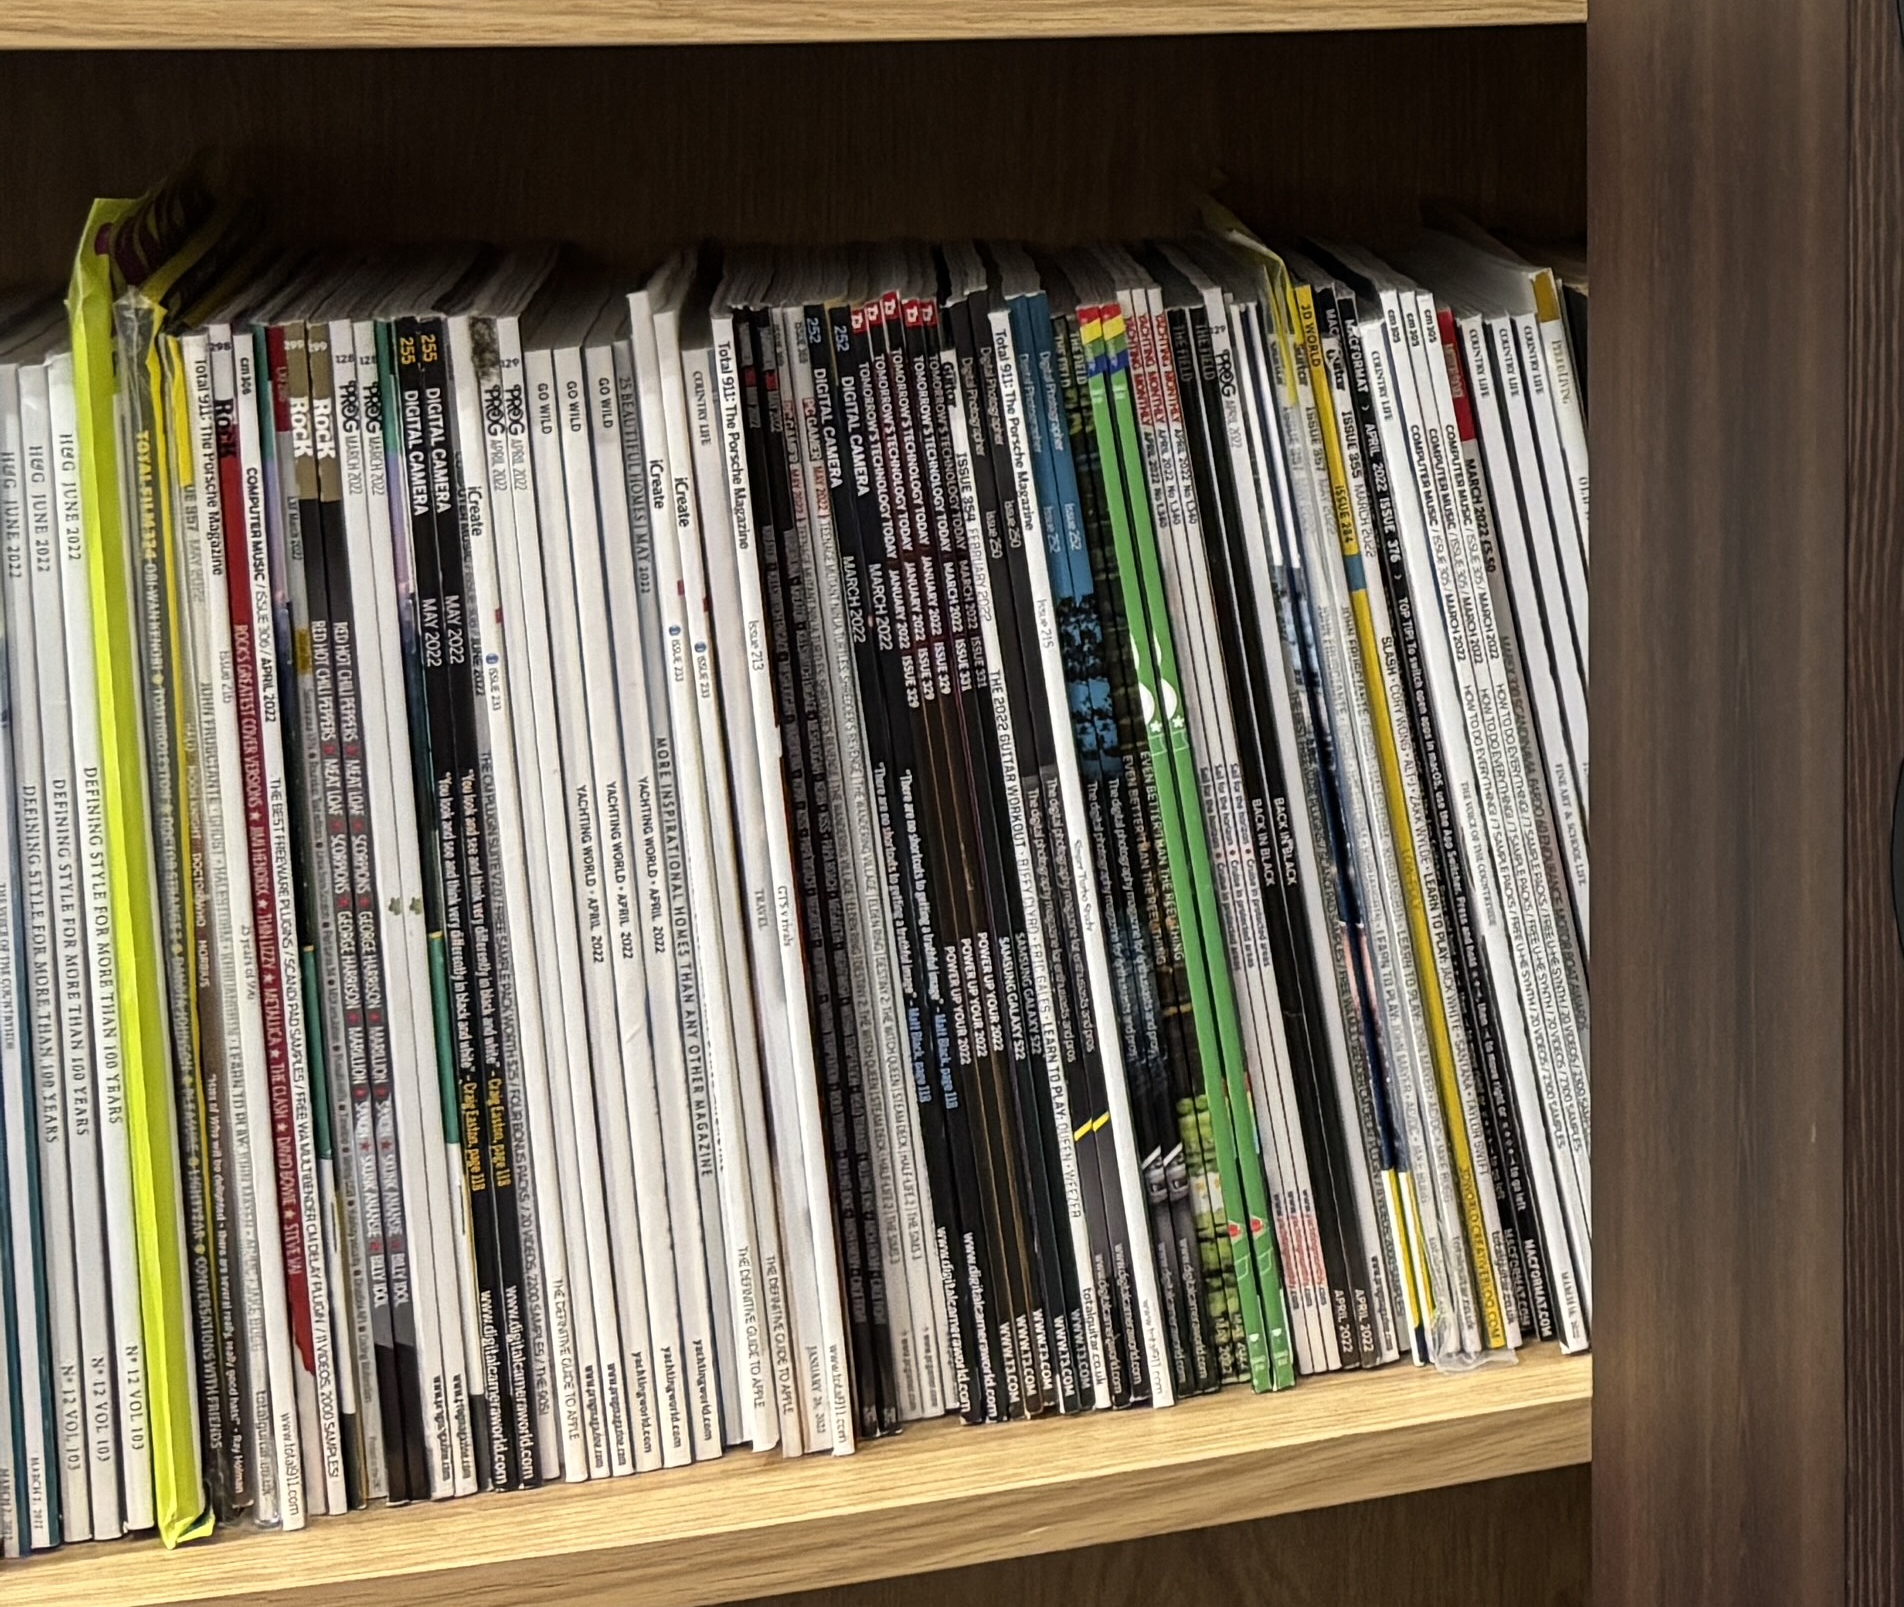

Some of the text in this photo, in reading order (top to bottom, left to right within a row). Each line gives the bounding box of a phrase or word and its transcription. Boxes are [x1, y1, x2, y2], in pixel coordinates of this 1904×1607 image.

[718, 341, 731, 374] Total
[1303, 323, 1323, 367] WORLD
[290, 398, 313, 458] ROCK
[538, 383, 552, 434] GO WILD
[727, 407, 738, 429] The
[728, 432, 742, 483] Porsche
[1345, 318, 1401, 563] MACFORMAT APRIL 2022 ISSUE 376
[421, 333, 465, 664] 255 DIGITAL CAMERA MAY 2022
[675, 477, 690, 528] iCreate
[1446, 424, 1473, 526] COMPUTER MUSIC
[734, 487, 749, 550] Magazine
[891, 347, 952, 695] TOMORROW'S TECHNOLOGY TODAY JANUARY 2022 ISSUE 329
[842, 555, 866, 643] MARCH 2022
[1478, 591, 1500, 659] MARCH 2022
[750, 650, 764, 671] 213
[1273, 797, 1291, 828] BACK
[577, 784, 605, 964] YACHTING WORLD APRIL 2022
[1280, 843, 1299, 886] BLACK
[84, 766, 123, 1124] DEFINING STYLE FOR MORE THAN 100 YEARS
[977, 931, 1003, 1051] POWER UP YOUR 2022
[999, 936, 1025, 1061] SAMSUNG GALAXY S22
[126, 1368, 140, 1388] 12
[127, 1390, 143, 1424] VOL
[131, 1425, 145, 1451] 103
